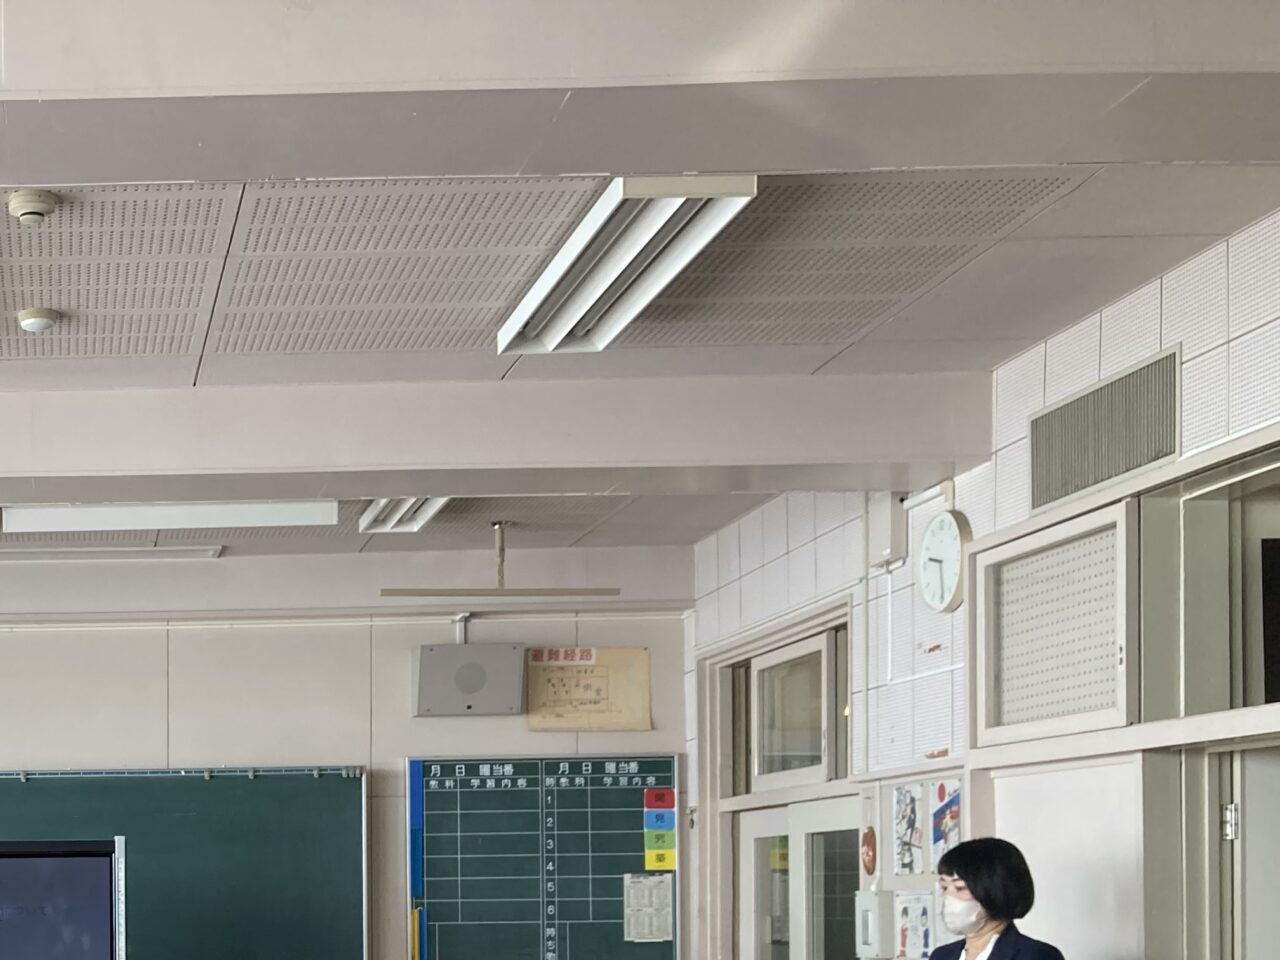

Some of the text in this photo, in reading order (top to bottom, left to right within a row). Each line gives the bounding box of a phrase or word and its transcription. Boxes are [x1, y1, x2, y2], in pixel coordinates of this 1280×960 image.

[430, 764, 441, 777] 月
[455, 764, 466, 777] 日
[558, 761, 569, 775] 月
[582, 761, 592, 775] 日
